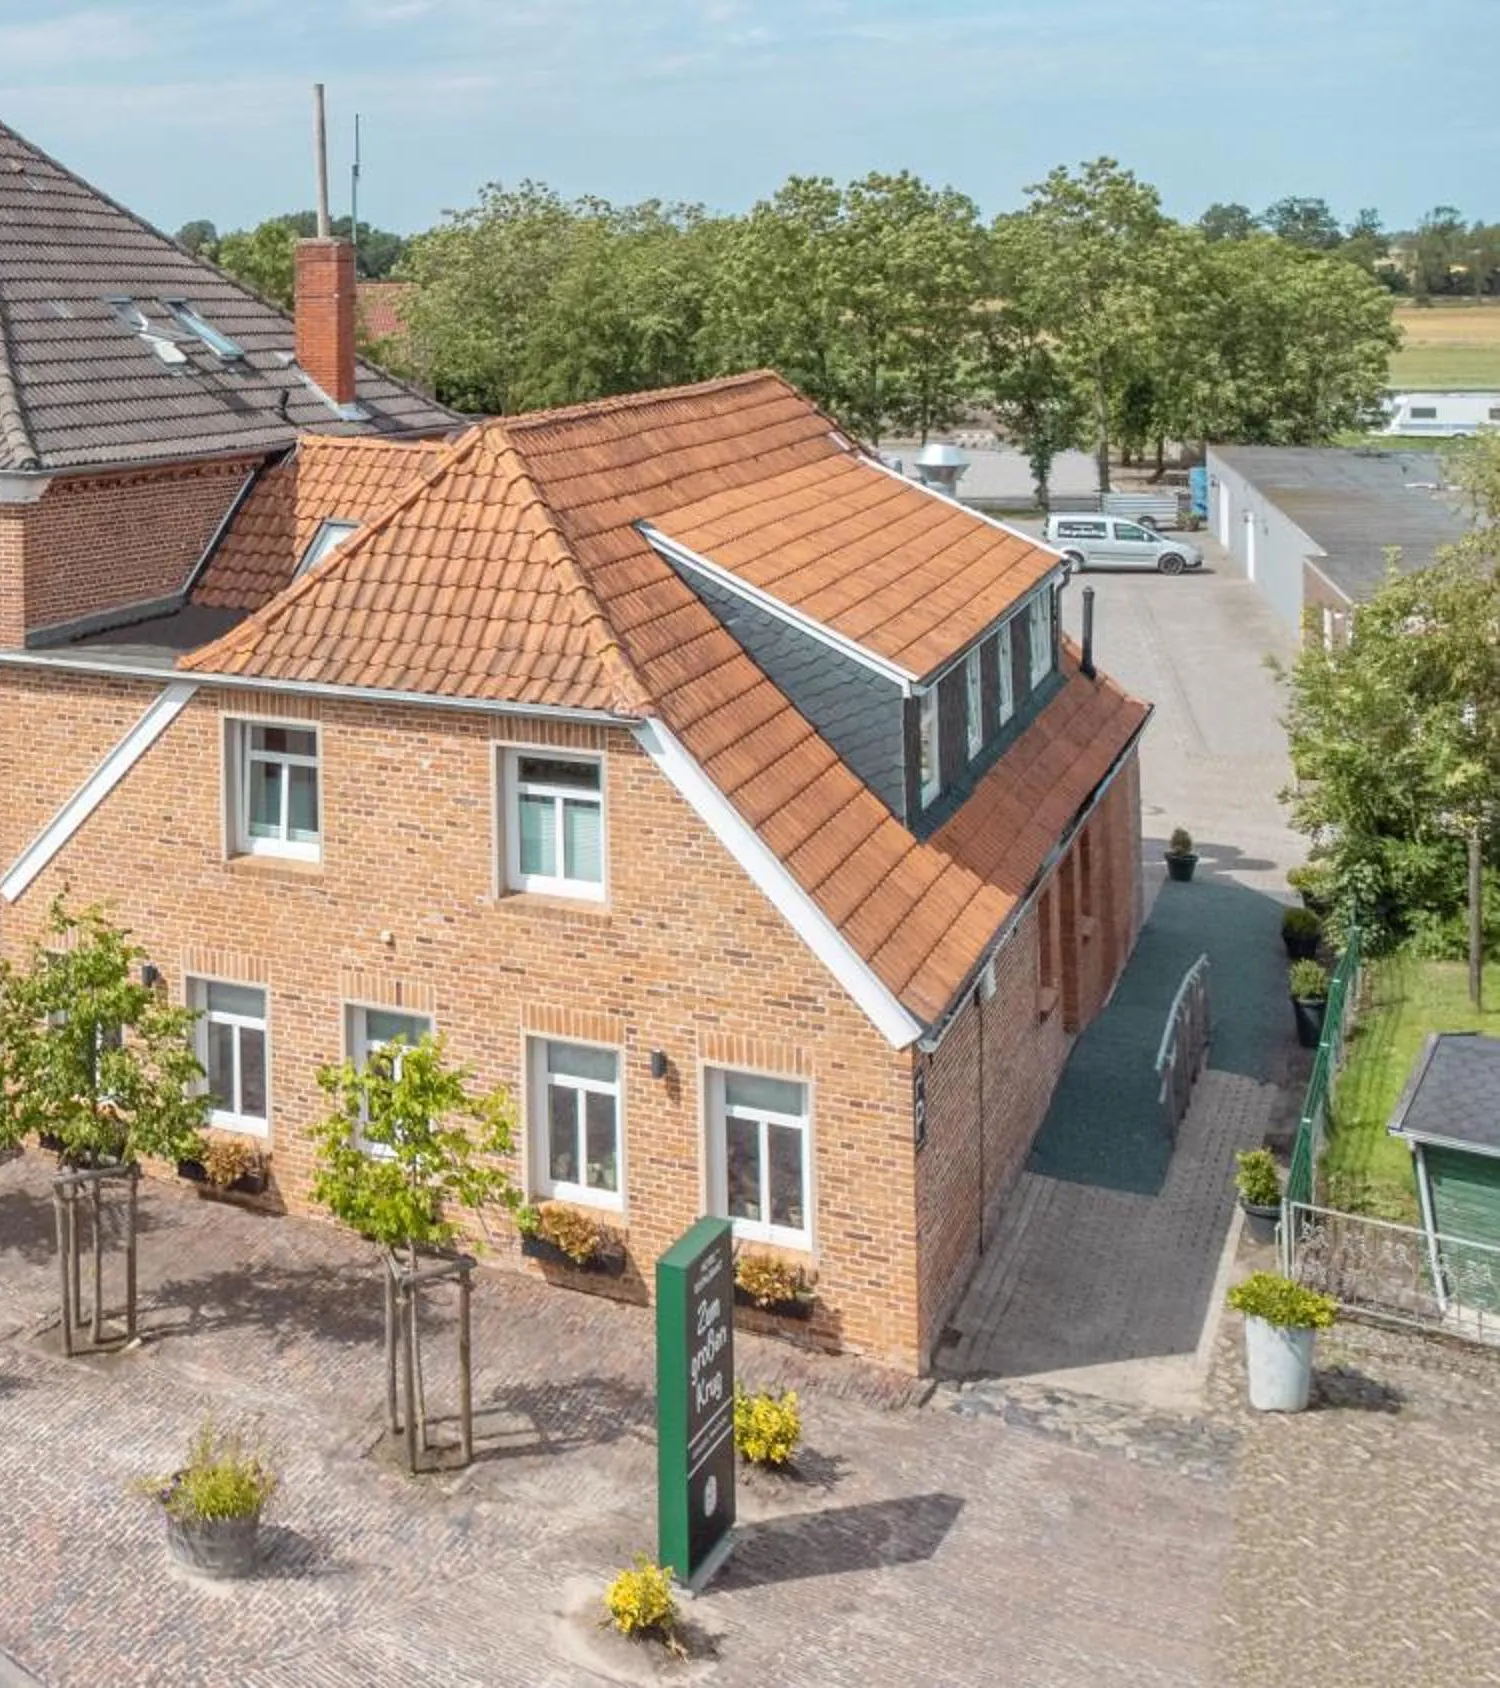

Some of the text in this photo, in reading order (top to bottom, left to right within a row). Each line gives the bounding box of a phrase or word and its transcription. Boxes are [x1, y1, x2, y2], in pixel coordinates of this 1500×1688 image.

[697, 1298, 721, 1337] Zum
[691, 1325, 727, 1386] großen
[695, 1370, 723, 1413] Krug
